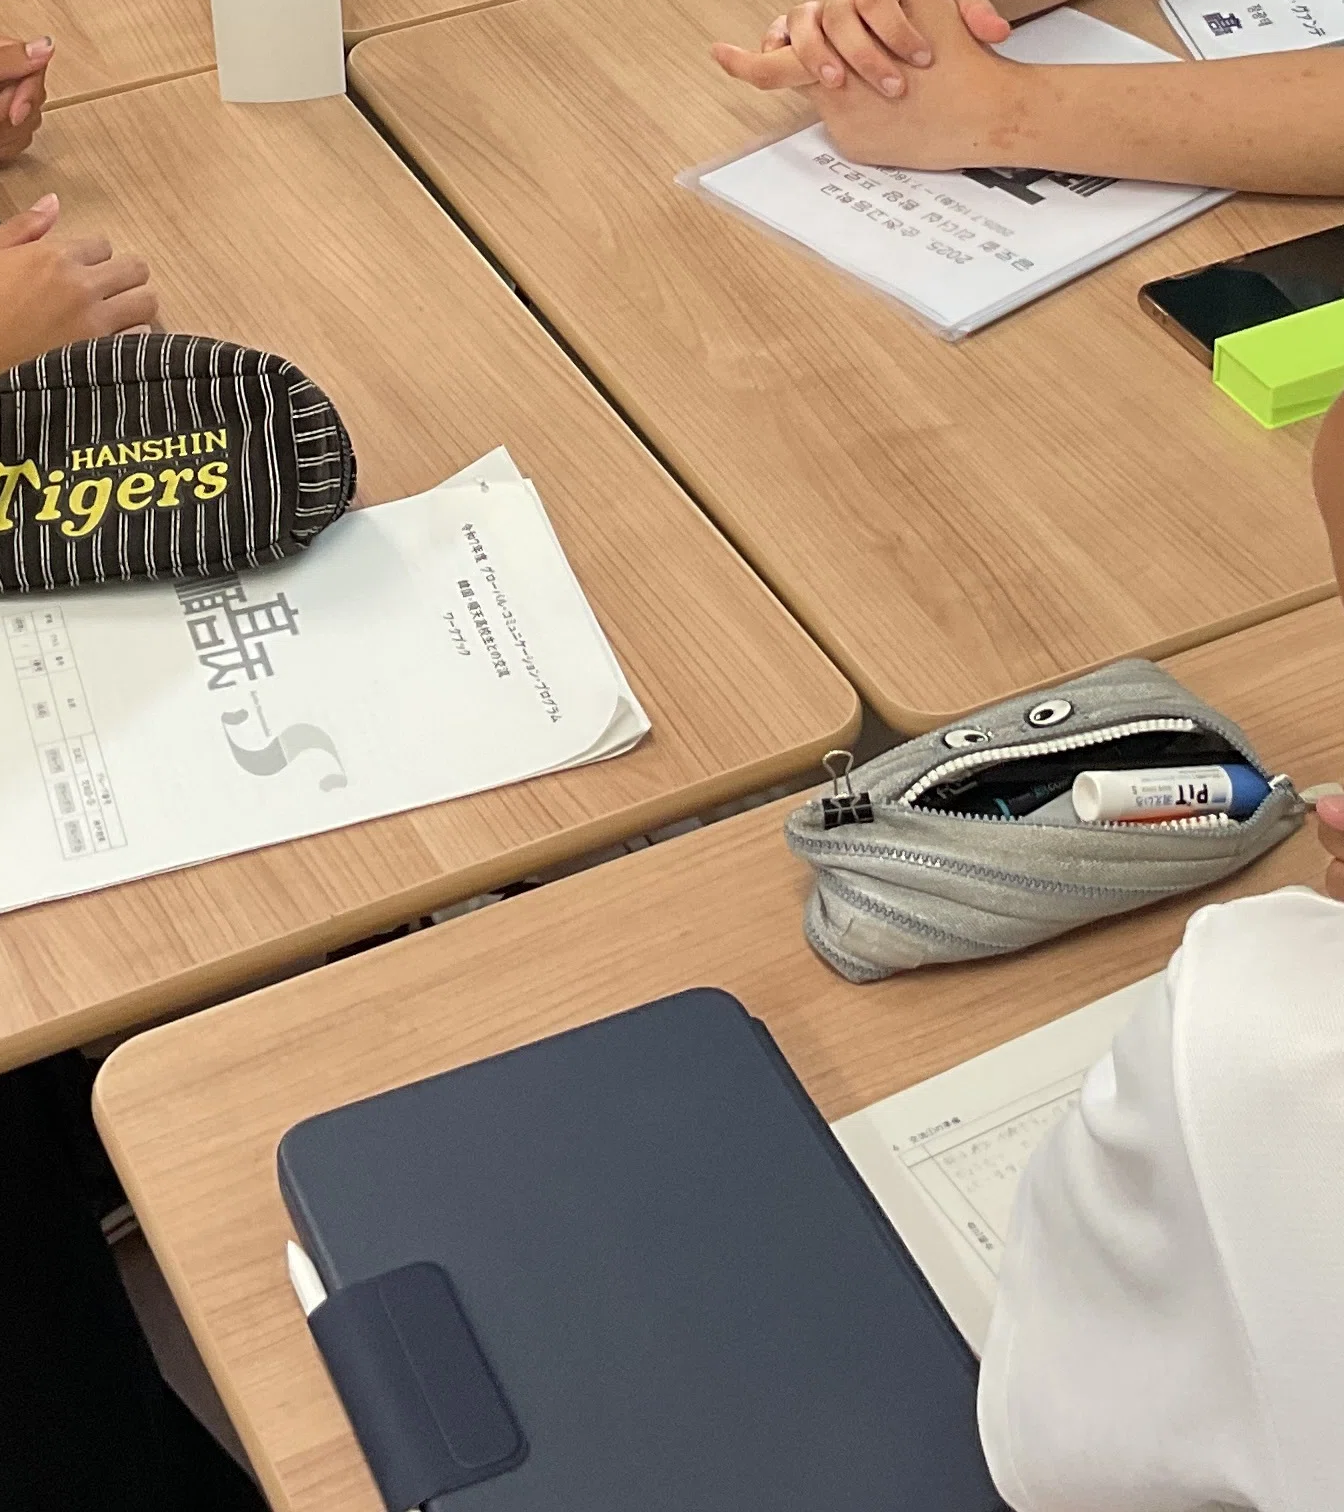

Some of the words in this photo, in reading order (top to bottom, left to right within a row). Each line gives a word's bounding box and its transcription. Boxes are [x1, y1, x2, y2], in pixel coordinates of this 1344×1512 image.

[812, 153, 881, 191] 프로그램
[820, 183, 921, 238] 순천고등학교
[71, 428, 228, 471] HANSHIN
[443, 611, 471, 656] ワークブック
